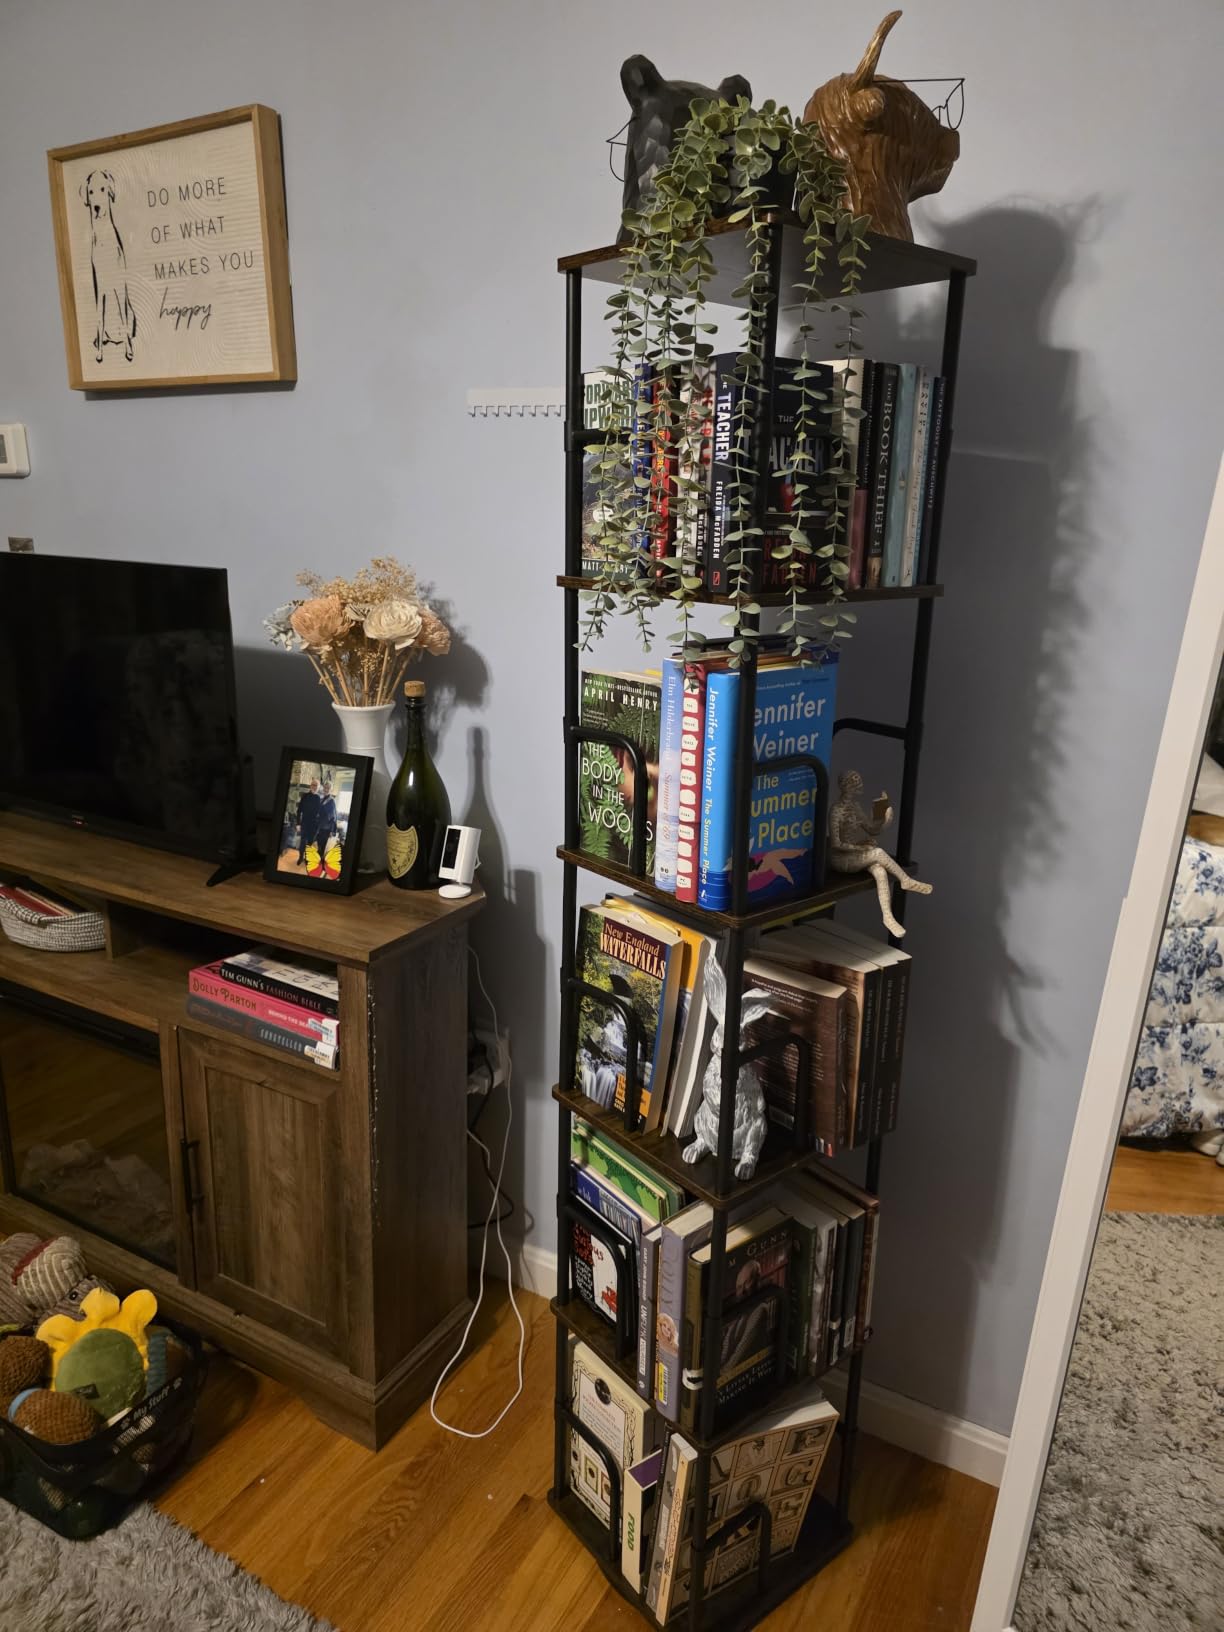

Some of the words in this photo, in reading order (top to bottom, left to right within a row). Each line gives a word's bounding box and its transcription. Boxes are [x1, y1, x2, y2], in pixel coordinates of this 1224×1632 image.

[147, 188, 169, 208] DO
[179, 177, 227, 202] MORE
[151, 224, 170, 244] OF
[180, 216, 225, 238] WHAT
[155, 257, 209, 280] MAKES
[219, 250, 254, 271] YOU
[159, 287, 212, 329] happy
[715, 392, 732, 461] TEACHER
[879, 401, 893, 465] BOOK
[933, 399, 943, 445] TATTOOIST
[715, 481, 723, 511] FREIDA
[874, 468, 888, 534] THIEF
[928, 459, 937, 509] AUSCHWITZ
[713, 514, 722, 559] McFADDEN
[582, 560, 600, 571] MATT
[584, 687, 615, 702] APRIL
[623, 694, 658, 711] HENRY
[707, 687, 719, 741] Jennifer
[754, 692, 826, 726] ennifer
[665, 699, 676, 760] Hilderbrand
[588, 743, 605, 758] THE
[582, 757, 622, 785] BODY
[706, 746, 716, 791] Weiner
[756, 774, 779, 793] The
[592, 783, 605, 798] IN
[606, 789, 625, 805] THE
[704, 798, 713, 815] The
[752, 788, 817, 817] ummer
[587, 802, 654, 842] WOOS
[702, 818, 711, 856] Summer
[758, 819, 813, 849] Place
[701, 859, 709, 885] Place
[600, 933, 666, 980] WATERFALLS
[605, 923, 624, 941] New
[625, 932, 660, 957] England
[193, 978, 220, 996] DOLLY
[220, 987, 257, 1011] PARTON
[221, 969, 235, 981] TIM
[236, 975, 265, 991] GUNN'S
[265, 984, 298, 1002] FASHION
[301, 997, 321, 1010] BIBLE
[133, 1405, 148, 1421] My
[148, 1385, 170, 1410] Stuff
